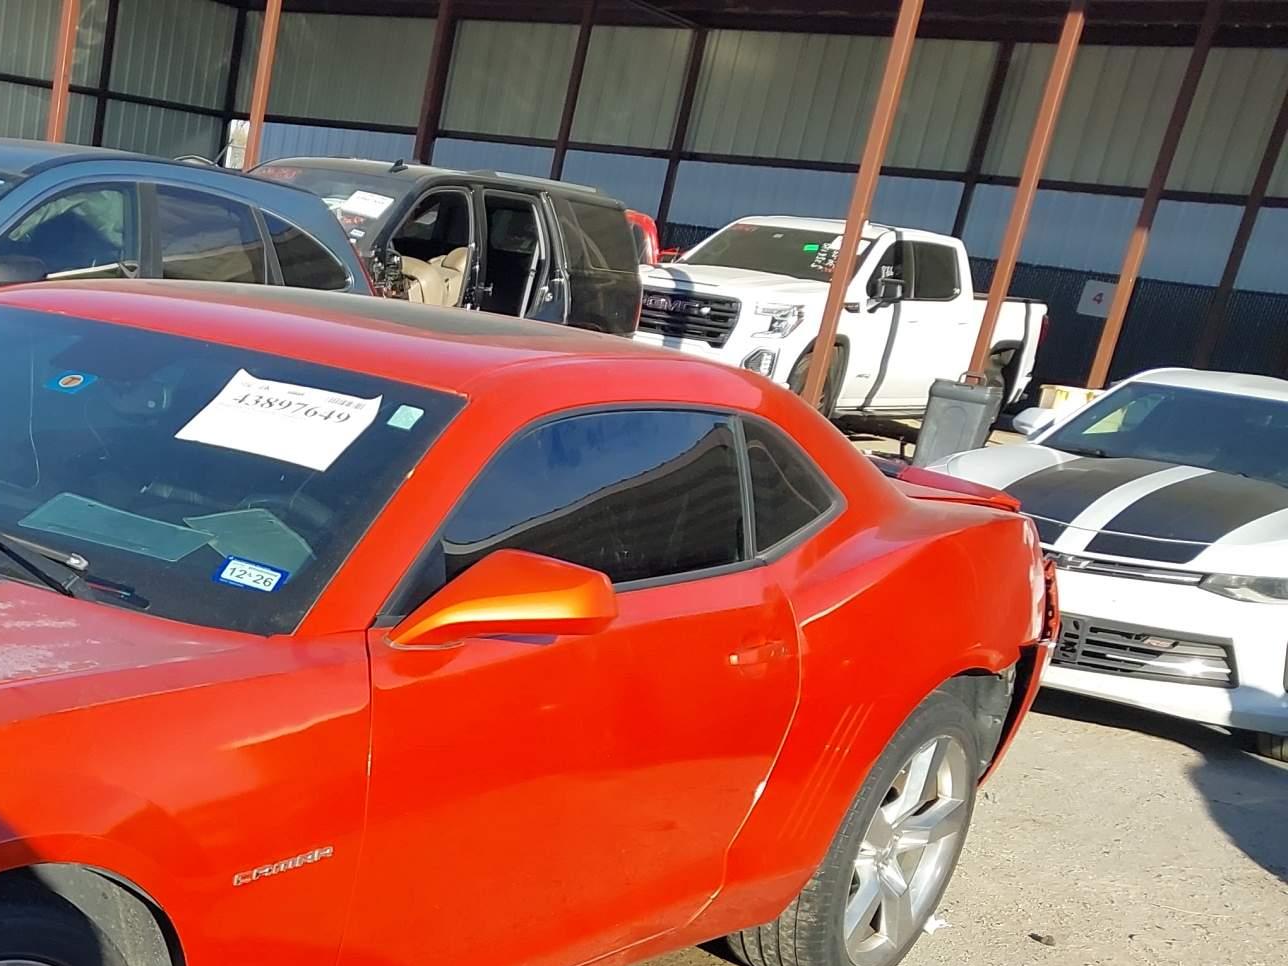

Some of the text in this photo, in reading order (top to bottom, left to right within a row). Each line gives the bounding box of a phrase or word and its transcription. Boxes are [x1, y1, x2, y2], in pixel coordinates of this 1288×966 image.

[1092, 292, 1104, 305] 4
[232, 392, 352, 425] 43897649
[228, 567, 275, 588] 12 26
[233, 846, 334, 887] CAMARO
